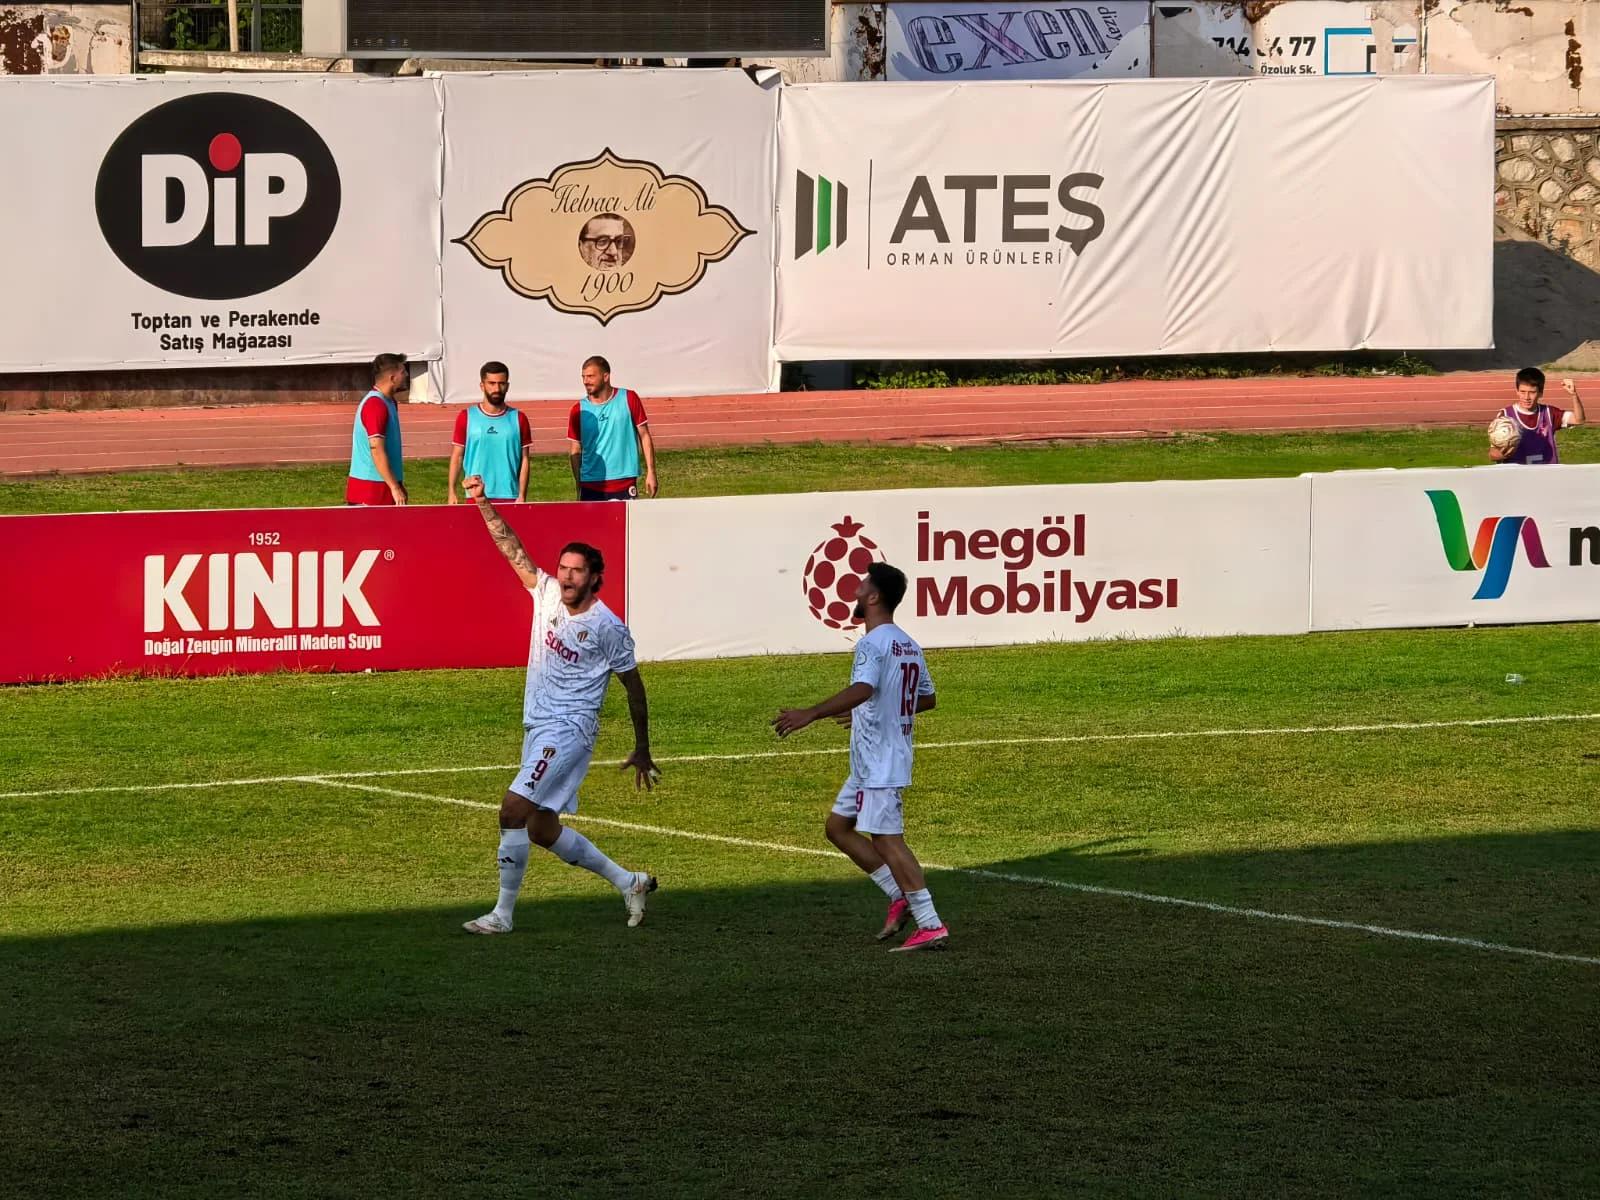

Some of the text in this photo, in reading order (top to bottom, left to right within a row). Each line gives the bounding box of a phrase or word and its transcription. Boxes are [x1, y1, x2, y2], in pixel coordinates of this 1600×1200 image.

[908, 8, 1112, 74] exen
[1289, 36, 1316, 57] 77
[1260, 62, 1317, 75] Özoluk Sk.
[623, 181, 657, 212] Ali
[888, 172, 1106, 257] ATEŞ
[886, 248, 1062, 266] ORMAN ÜRÜNLERİ
[580, 272, 635, 303] 1900
[130, 308, 321, 334] Toptan ve Perakende
[159, 332, 292, 354] Satış Mağazası
[248, 532, 281, 546] 1952
[917, 510, 1086, 570] İnegöl
[144, 549, 382, 633] KINIK
[916, 569, 1178, 623] Mobilyası
[144, 633, 382, 656] Doğal Zengin Mineralli Maden Suyu
[531, 759, 549, 782] 9
